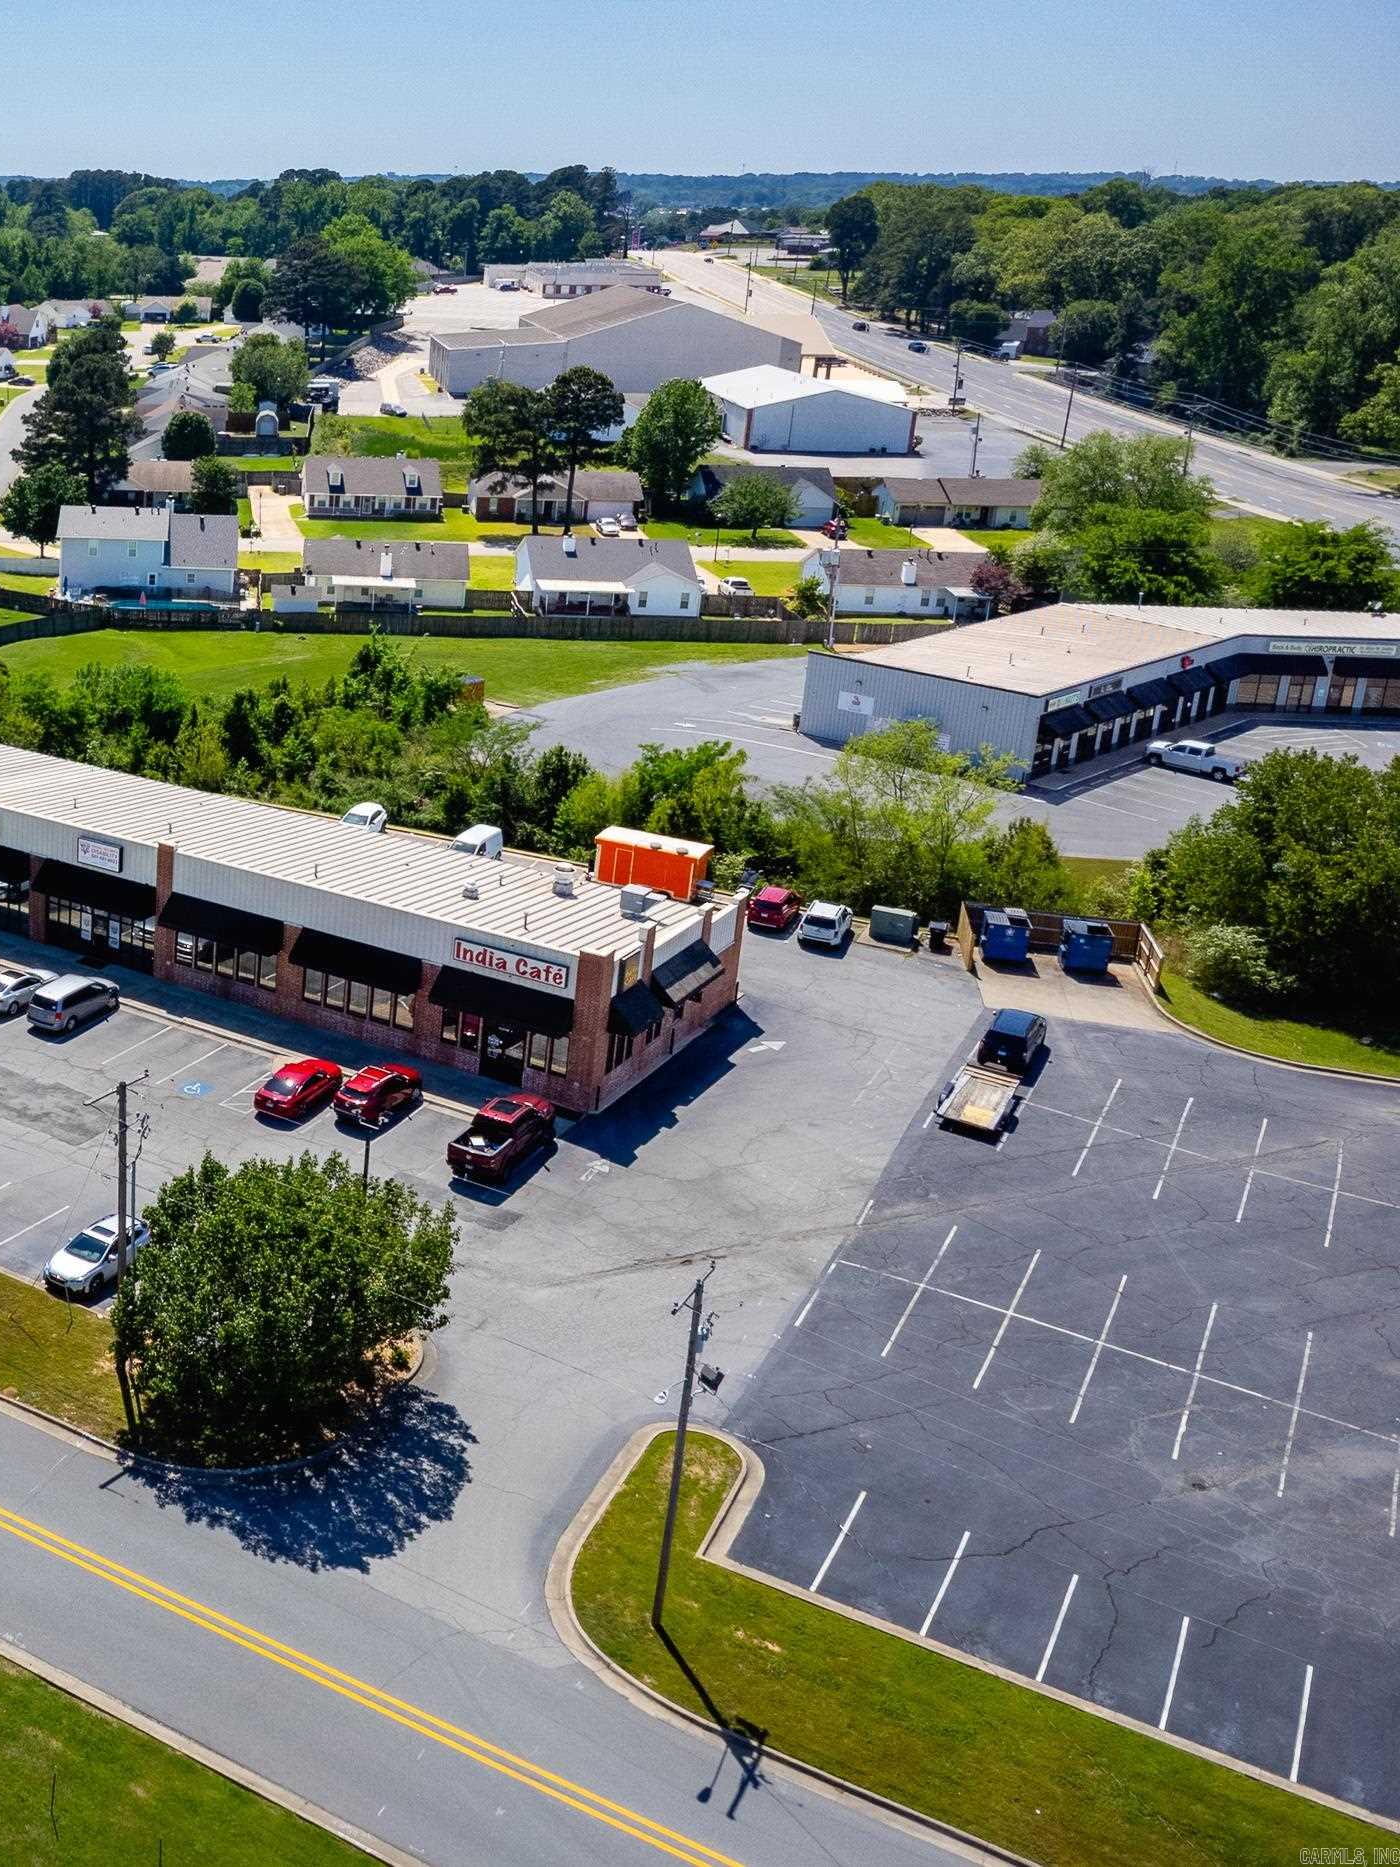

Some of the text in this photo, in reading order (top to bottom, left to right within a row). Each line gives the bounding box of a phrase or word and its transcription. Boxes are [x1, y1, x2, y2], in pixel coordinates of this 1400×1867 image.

[1304, 643, 1357, 655] CHIROPRACTIC
[91, 847, 118, 860] DISABILITY
[455, 941, 563, 985] India Café
